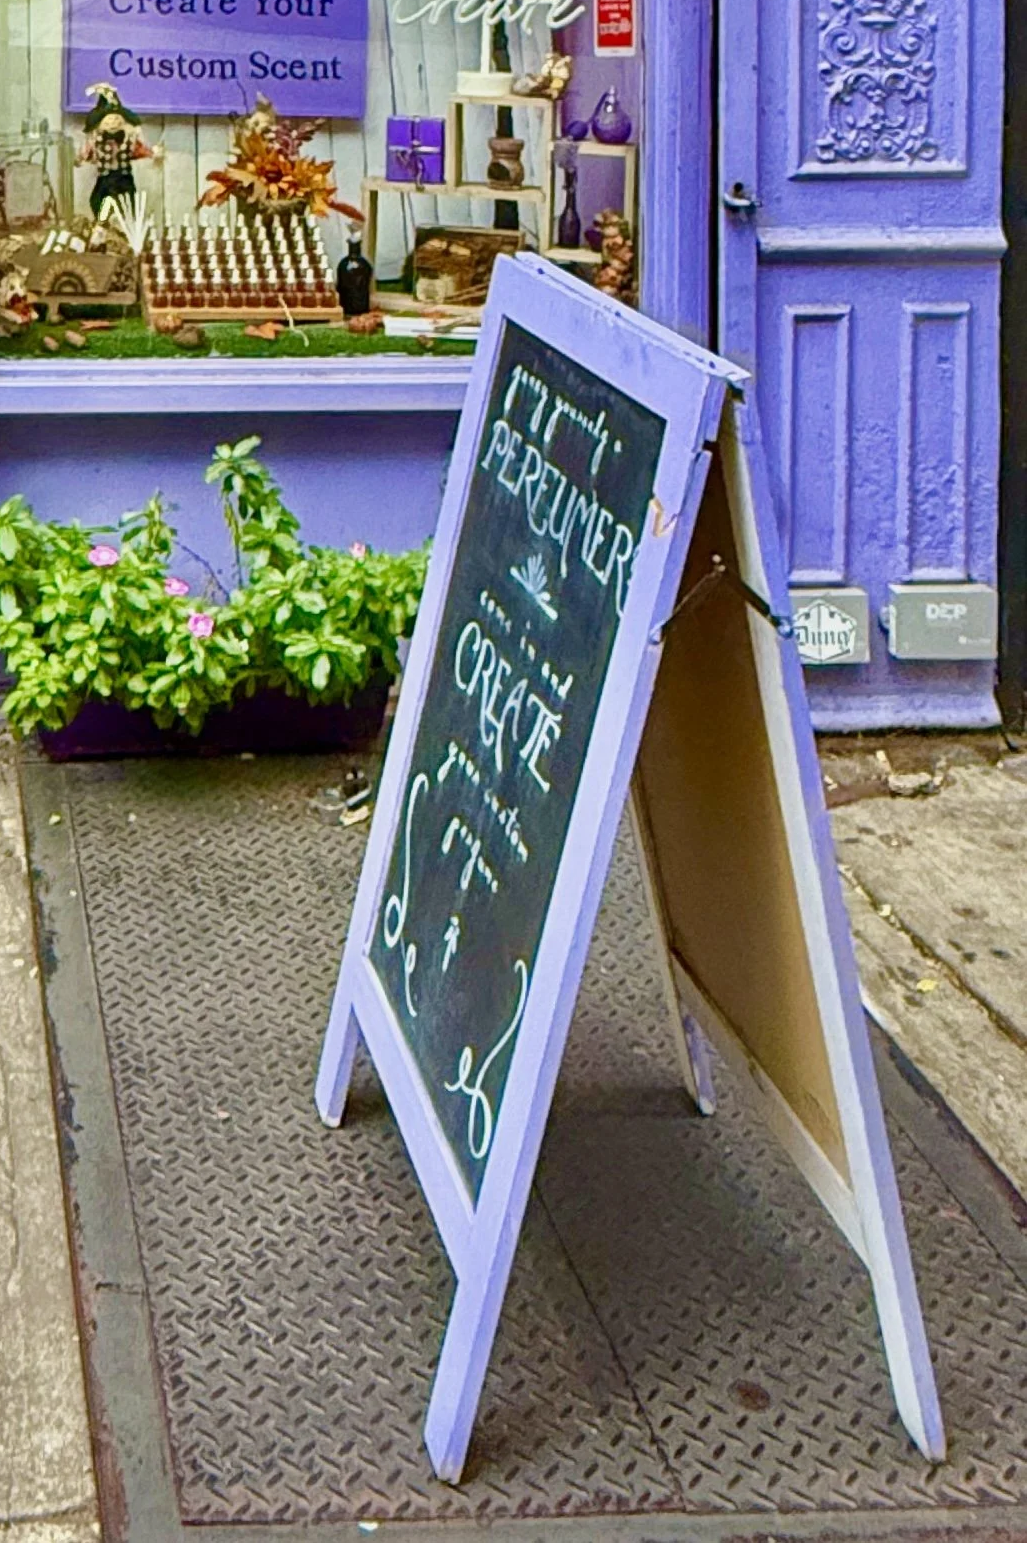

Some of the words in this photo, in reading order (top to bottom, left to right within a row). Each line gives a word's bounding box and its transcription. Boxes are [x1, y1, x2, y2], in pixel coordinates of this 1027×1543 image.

[109, 48, 237, 79] Custom
[249, 50, 343, 81] Scent
[519, 620, 535, 660] in
[541, 661, 573, 700] and
[454, 621, 562, 793] CREATE
[483, 789, 528, 862] custom
